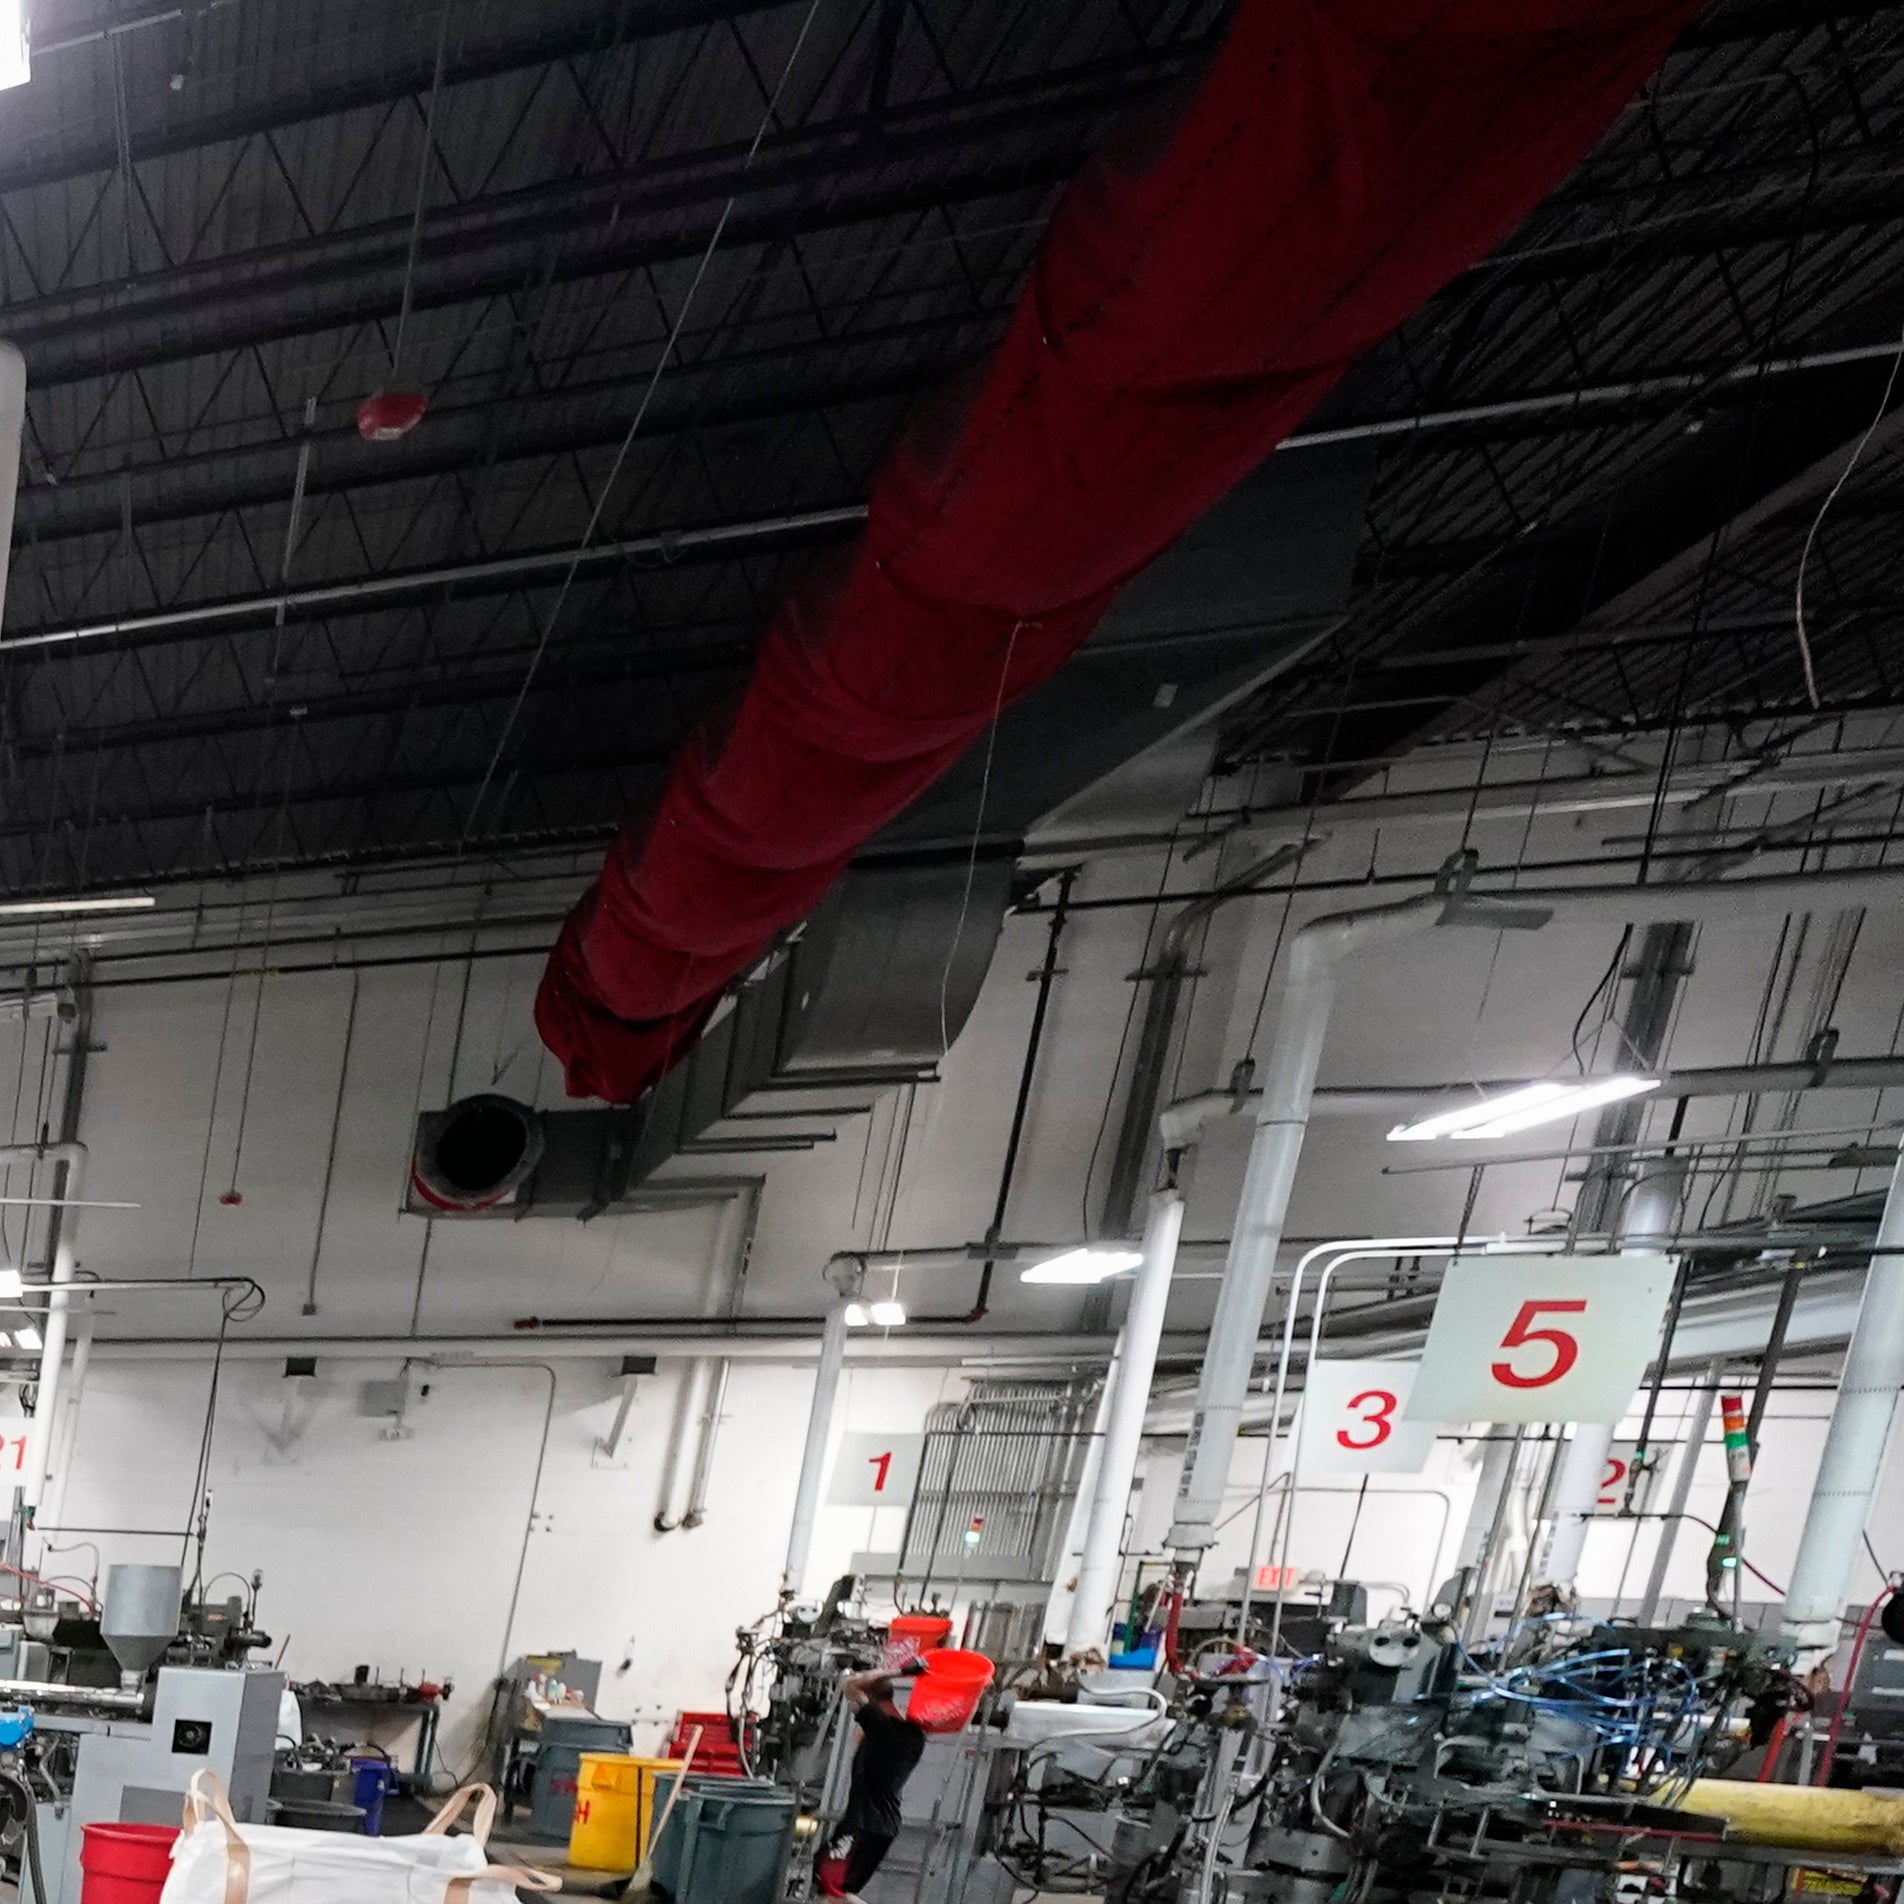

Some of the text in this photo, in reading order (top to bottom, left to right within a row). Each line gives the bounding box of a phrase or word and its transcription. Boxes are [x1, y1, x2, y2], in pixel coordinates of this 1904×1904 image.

[1491, 1299, 1588, 1390] 5
[1336, 1388, 1399, 1450] 3
[869, 1451, 892, 1492] 1
[1258, 1567, 1295, 1588] EXIT
